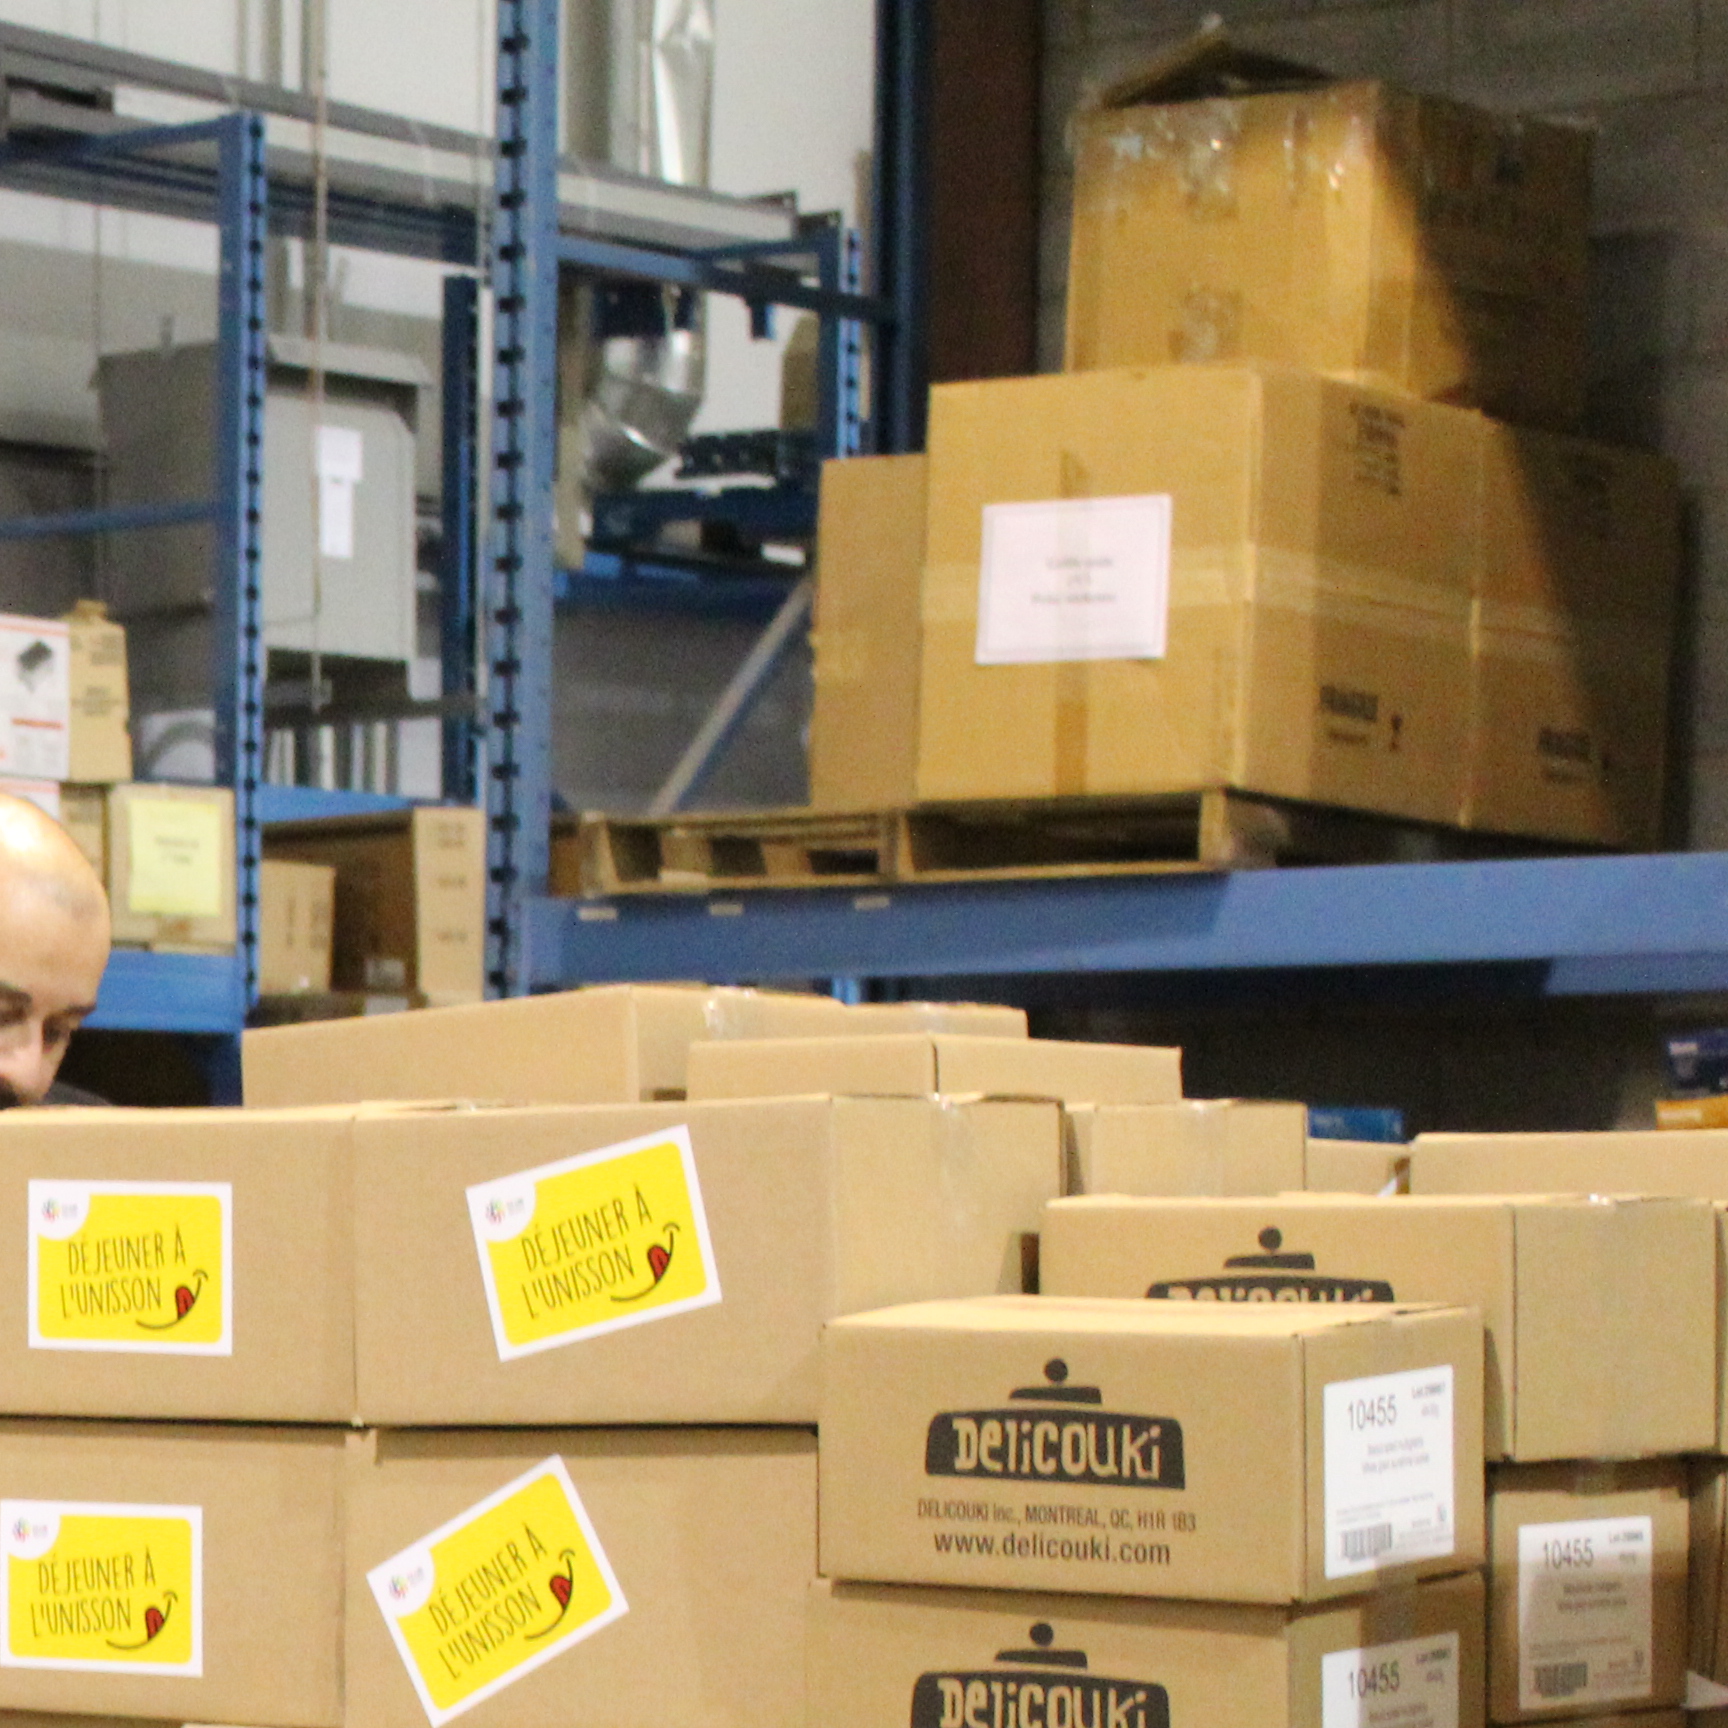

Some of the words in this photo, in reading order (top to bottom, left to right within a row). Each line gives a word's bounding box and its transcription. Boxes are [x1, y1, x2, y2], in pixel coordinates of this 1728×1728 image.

[68, 1231, 165, 1275] DÉJEUNER
[521, 1197, 629, 1273] DÉJEUNER
[61, 1277, 161, 1319] L'UNISSON
[521, 1244, 635, 1319] L'UNISSON
[1347, 1394, 1397, 1431] 10455
[917, 1498, 988, 1522] DELICOUKI
[934, 1531, 1171, 1565] www.delicouki.com
[1544, 1538, 1593, 1569] 10455
[38, 1553, 134, 1595] DÉJEUNER
[429, 1541, 527, 1636] DÉJEUNER
[30, 1597, 131, 1638] L'UNISSON
[438, 1582, 542, 1680] L'UNISSON
[1348, 1660, 1400, 1698] 10455
